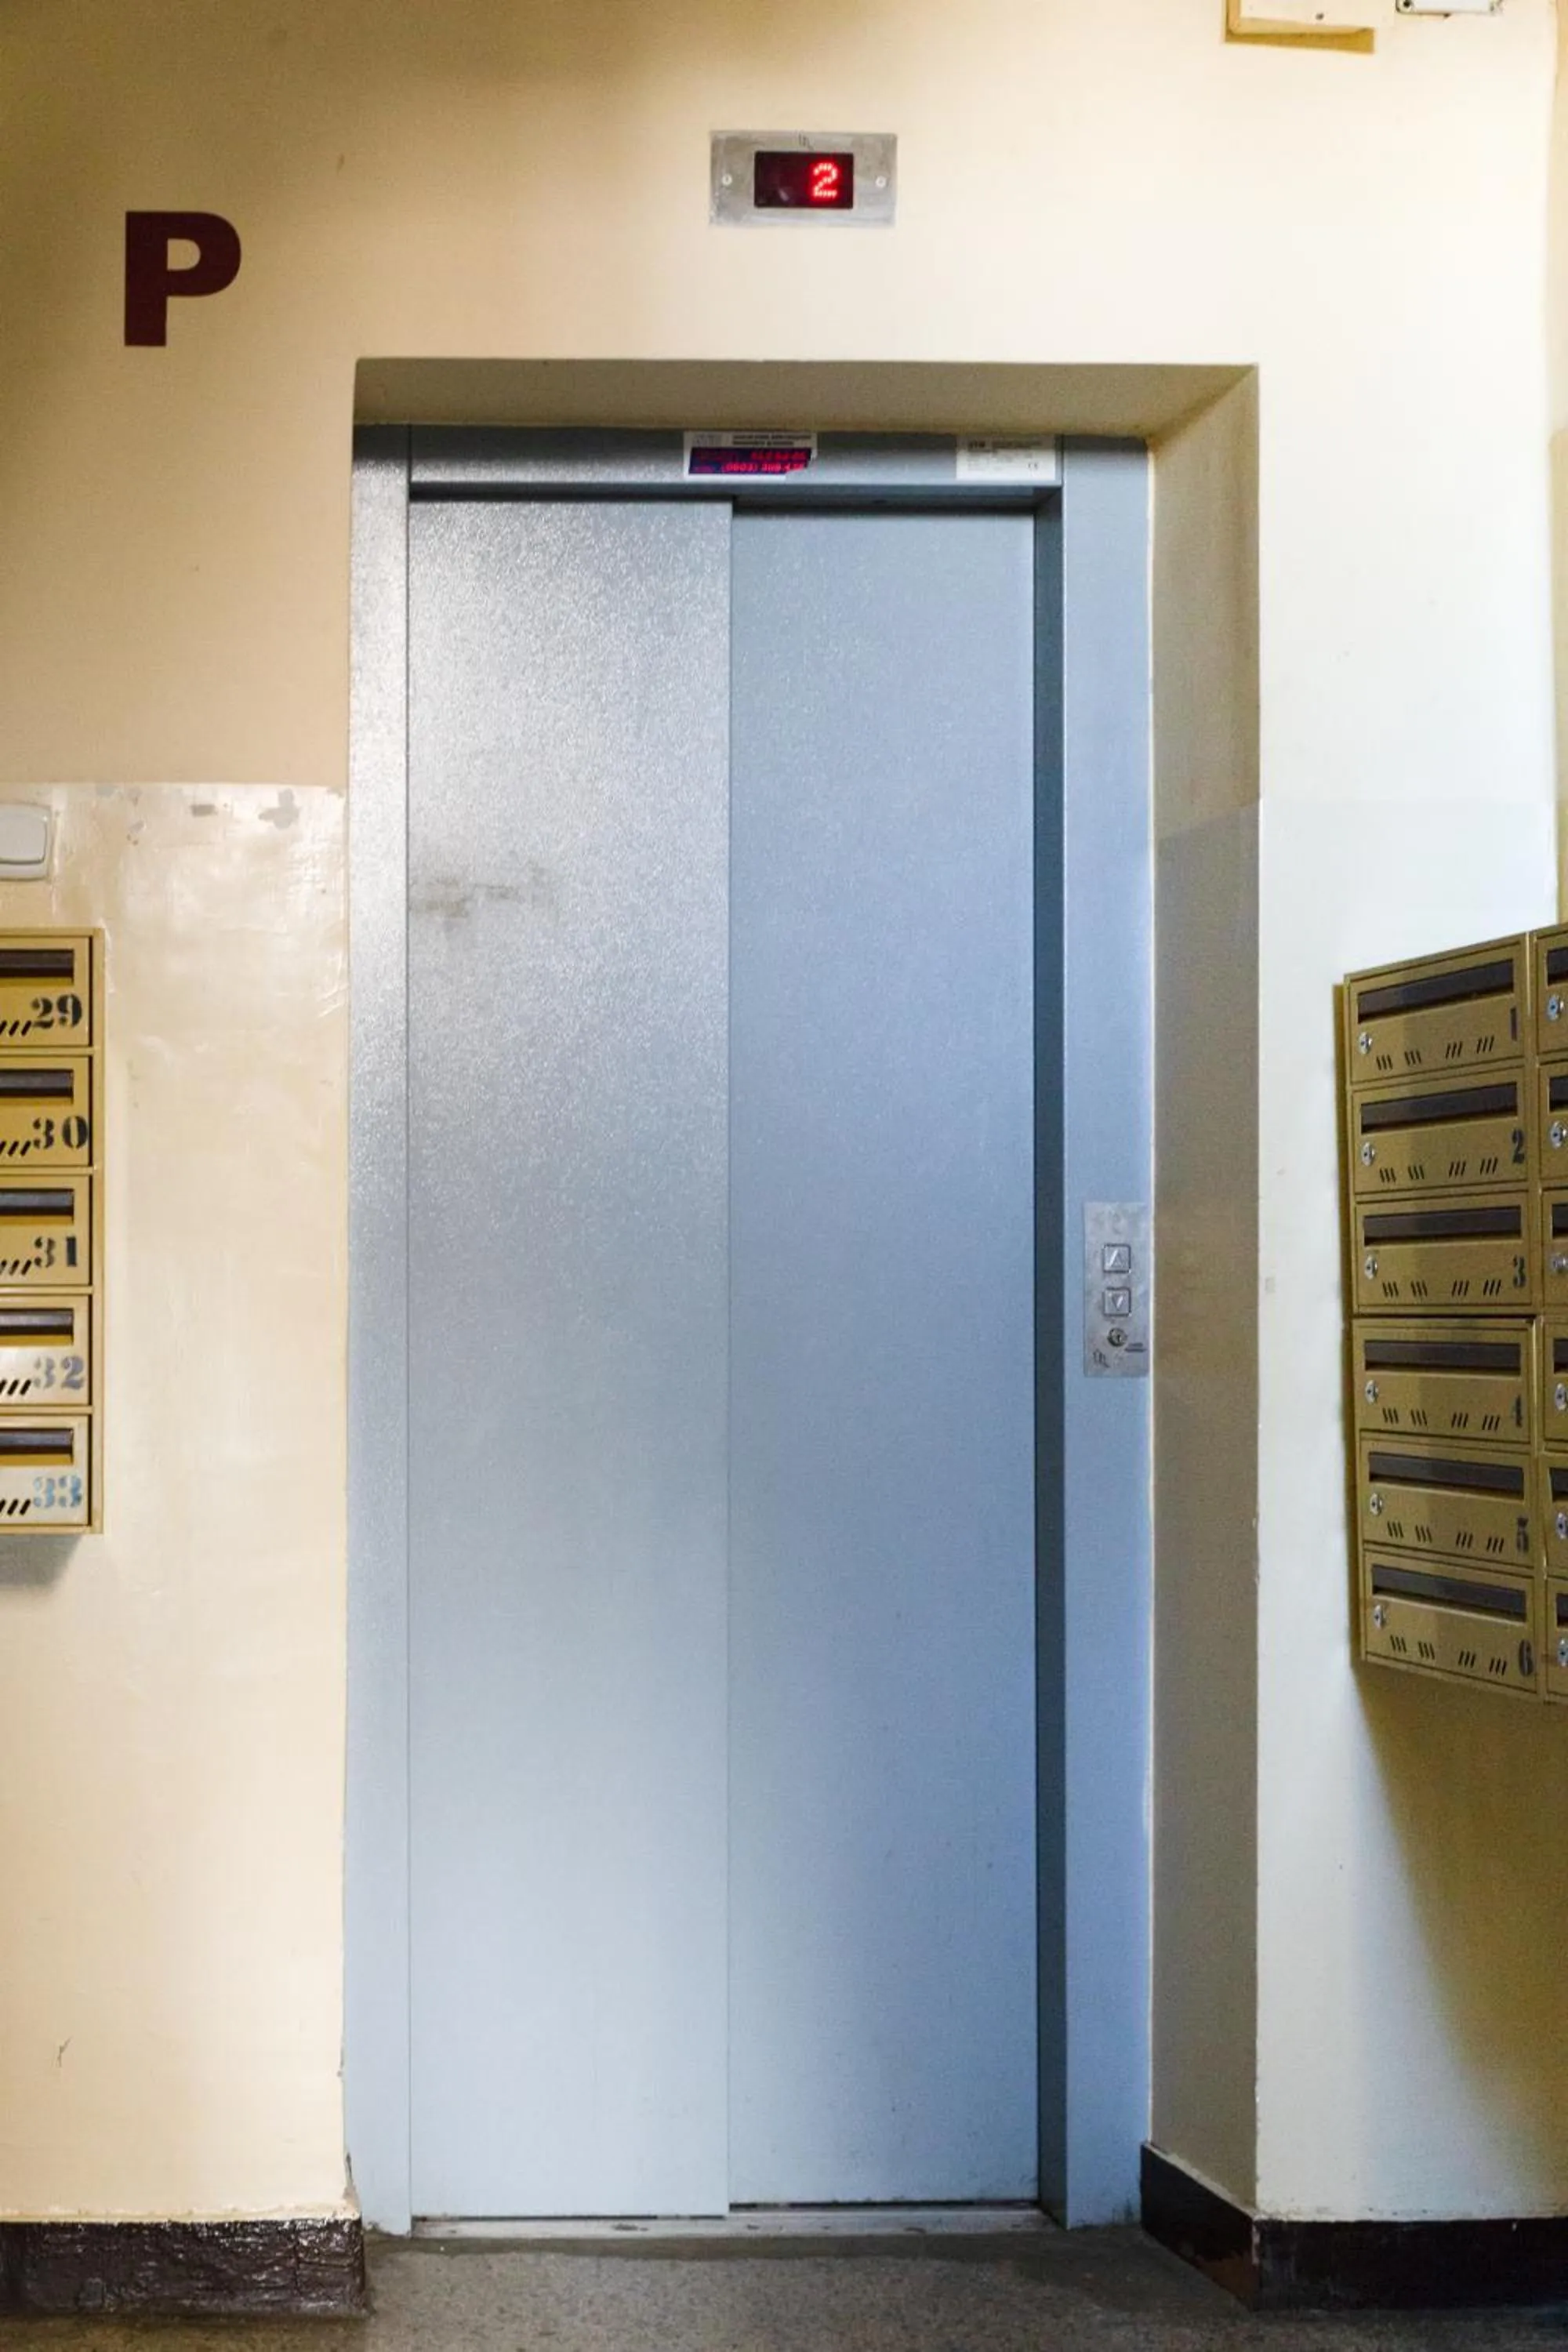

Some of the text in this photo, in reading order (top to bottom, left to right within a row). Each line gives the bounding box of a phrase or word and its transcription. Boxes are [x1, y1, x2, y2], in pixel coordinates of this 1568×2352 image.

[812, 162, 838, 198] 2
[125, 212, 241, 346] P
[31, 994, 83, 1029] 29
[1510, 1006, 1518, 1041] 1
[33, 1116, 89, 1149] 30
[1512, 1127, 1525, 1164] 2
[34, 1236, 77, 1268] 31
[1513, 1254, 1526, 1288] 3
[34, 1356, 85, 1389] 32
[33, 1475, 82, 1508] 33
[1515, 1516, 1529, 1552] 5
[1519, 1639, 1534, 1677] 6
